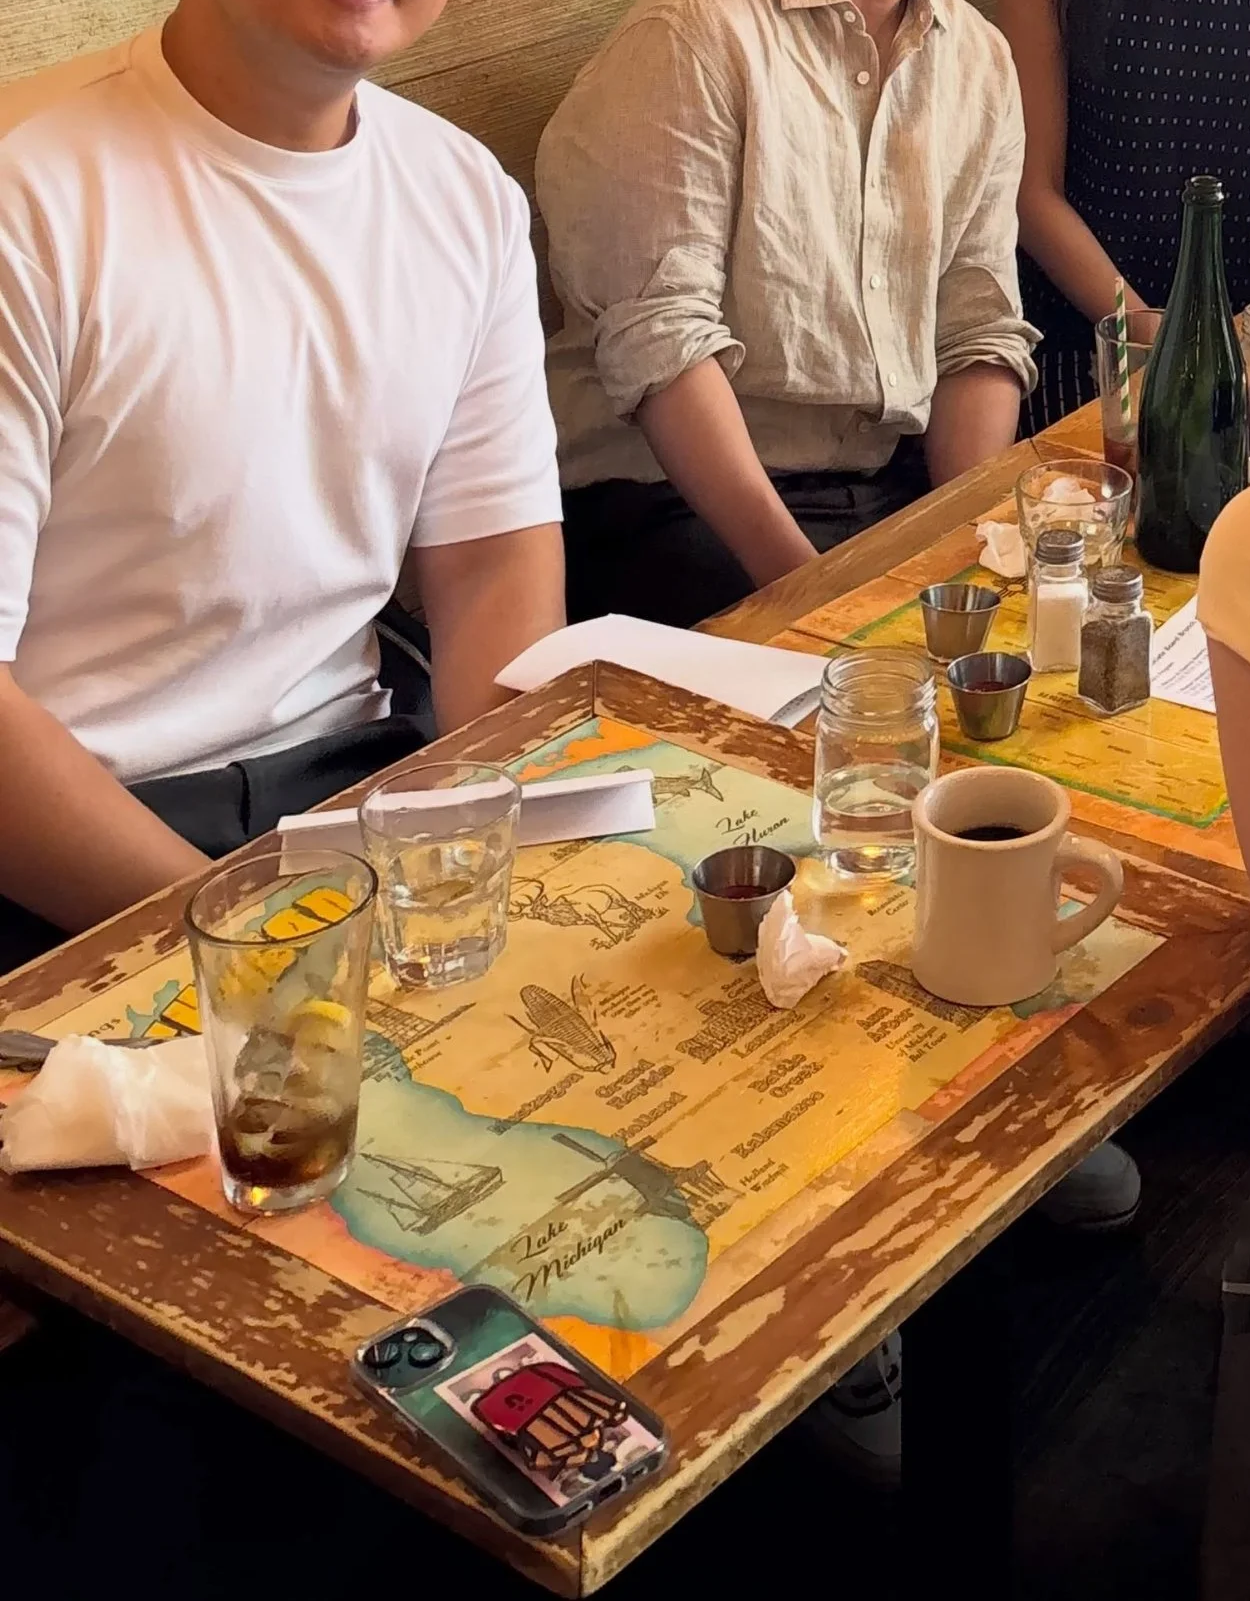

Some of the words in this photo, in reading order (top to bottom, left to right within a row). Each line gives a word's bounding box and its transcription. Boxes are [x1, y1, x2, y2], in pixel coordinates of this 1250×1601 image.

[715, 809, 759, 835] Lake
[732, 817, 790, 847] Huron
[866, 1007, 915, 1043] Arbor
[595, 1058, 656, 1098] Grand
[606, 1064, 675, 1110] Rapids
[769, 1061, 824, 1098] Creek
[730, 1091, 825, 1159] Kalamazoo
[509, 1221, 569, 1265] Lake
[510, 1218, 627, 1303] Michigan
